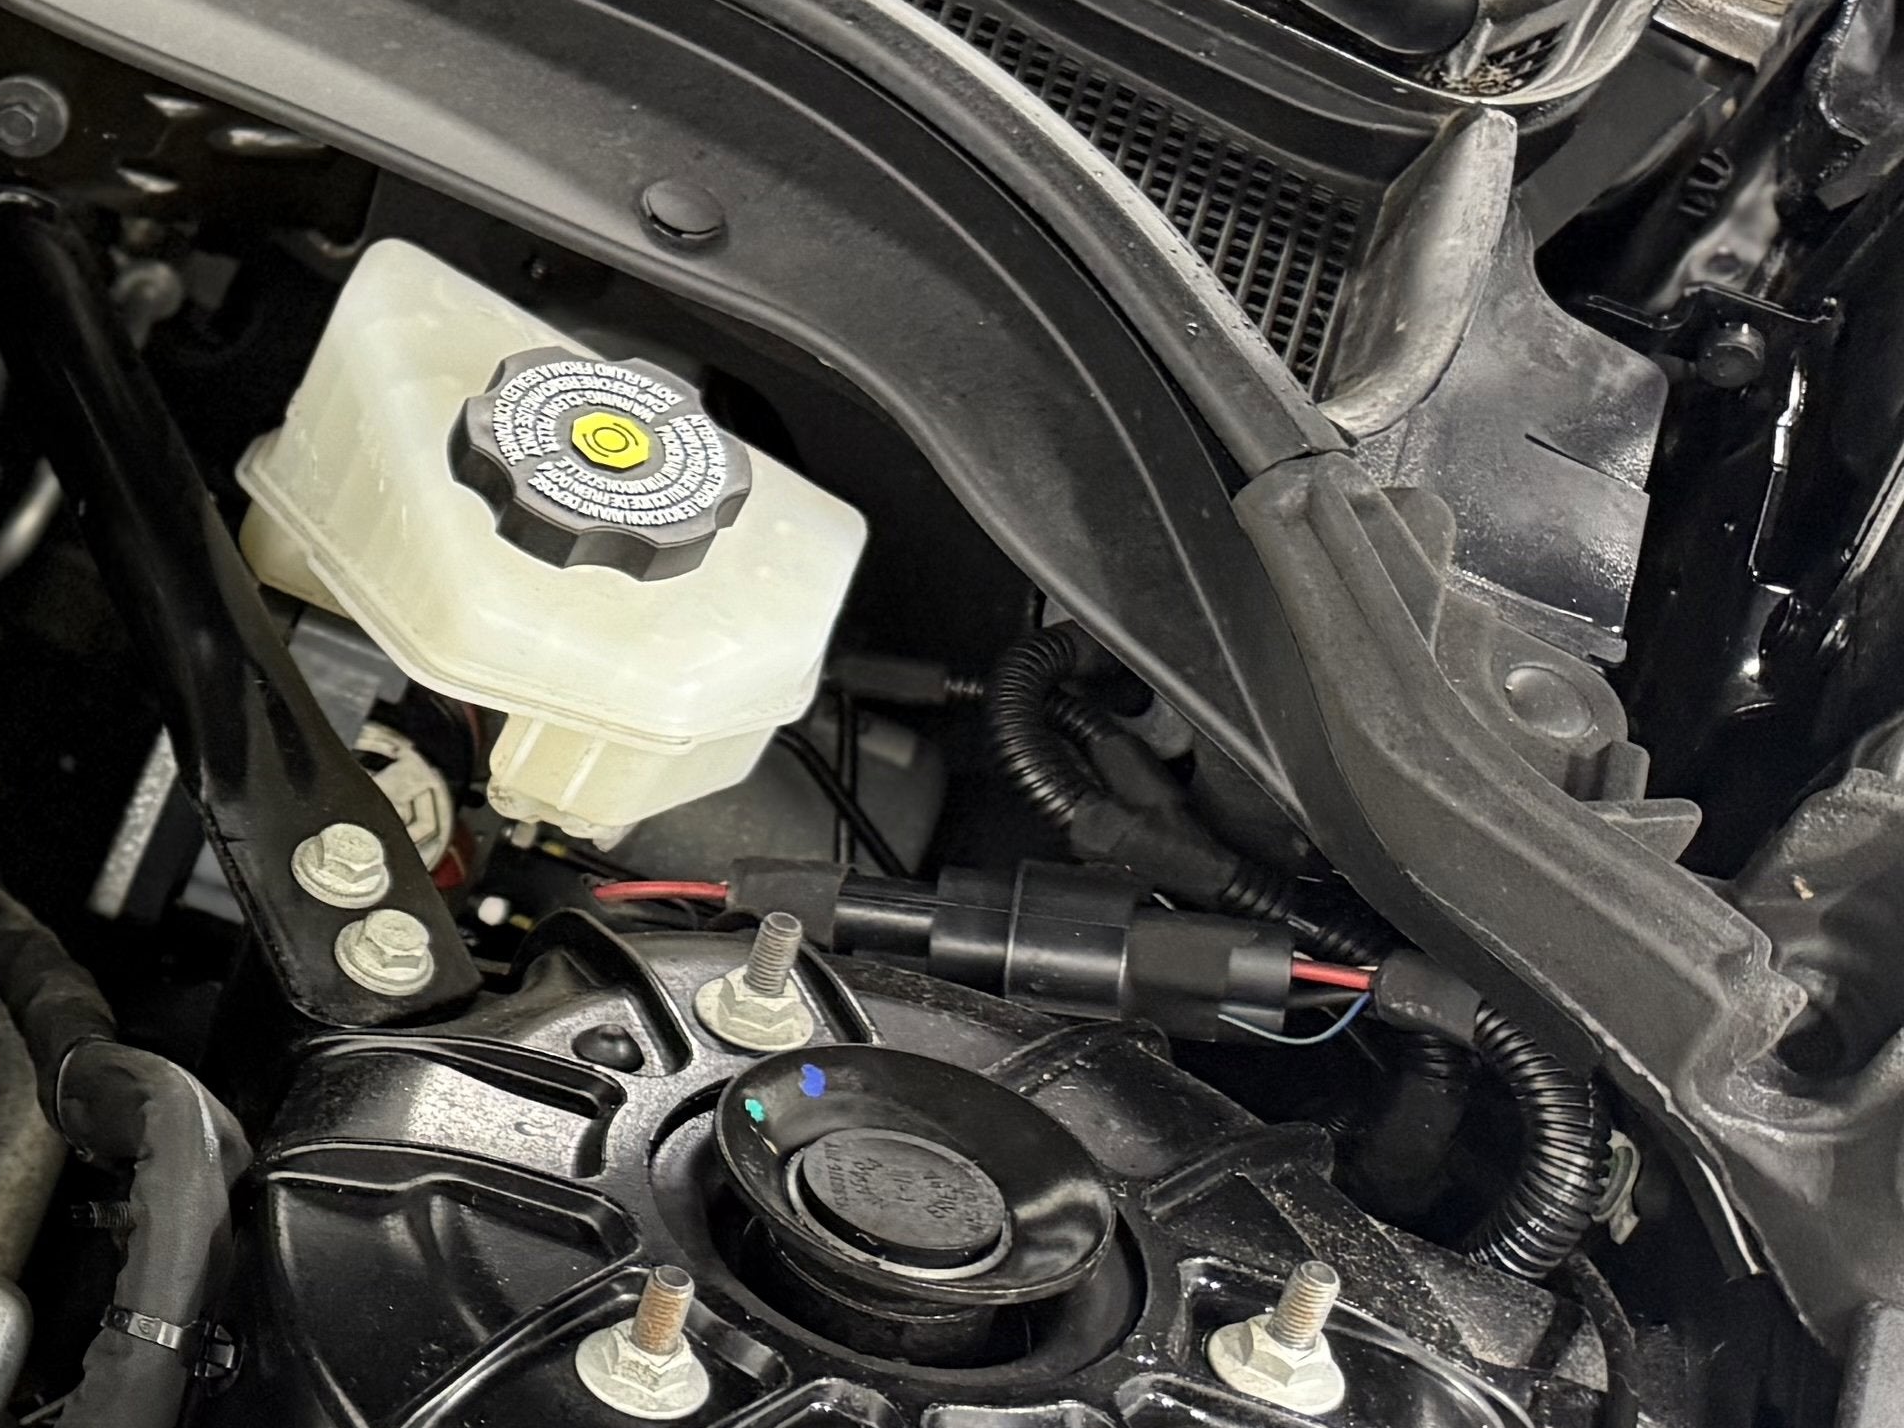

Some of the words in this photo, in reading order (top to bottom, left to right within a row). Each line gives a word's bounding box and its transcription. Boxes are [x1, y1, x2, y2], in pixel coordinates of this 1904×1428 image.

[534, 365, 552, 378] A
[547, 361, 594, 376] FROM
[595, 363, 641, 384] FLUID
[500, 369, 544, 401] SEALED
[577, 376, 639, 398] BEFORE
[640, 377, 654, 390] 4
[647, 381, 685, 405] DOT
[541, 392, 583, 419] CLEAN
[636, 394, 671, 412] CAP
[514, 406, 536, 428] USE
[493, 399, 525, 465] CONTAINER.
[515, 428, 543, 456] ONLY
[536, 415, 561, 453] FILLER
[654, 425, 685, 480] PROVENANT
[536, 461, 556, 472] 4
[543, 467, 574, 488] DOT
[678, 471, 703, 491] QUE
[690, 464, 728, 508] NETTOYER
[569, 481, 609, 504] FREIN
[610, 494, 629, 509] DE
[627, 490, 676, 509] LIQUIDE
[667, 484, 691, 500] DU
[578, 501, 624, 523] AVANT
[625, 506, 687, 524] BOUCHON
[677, 500, 701, 516] LE
